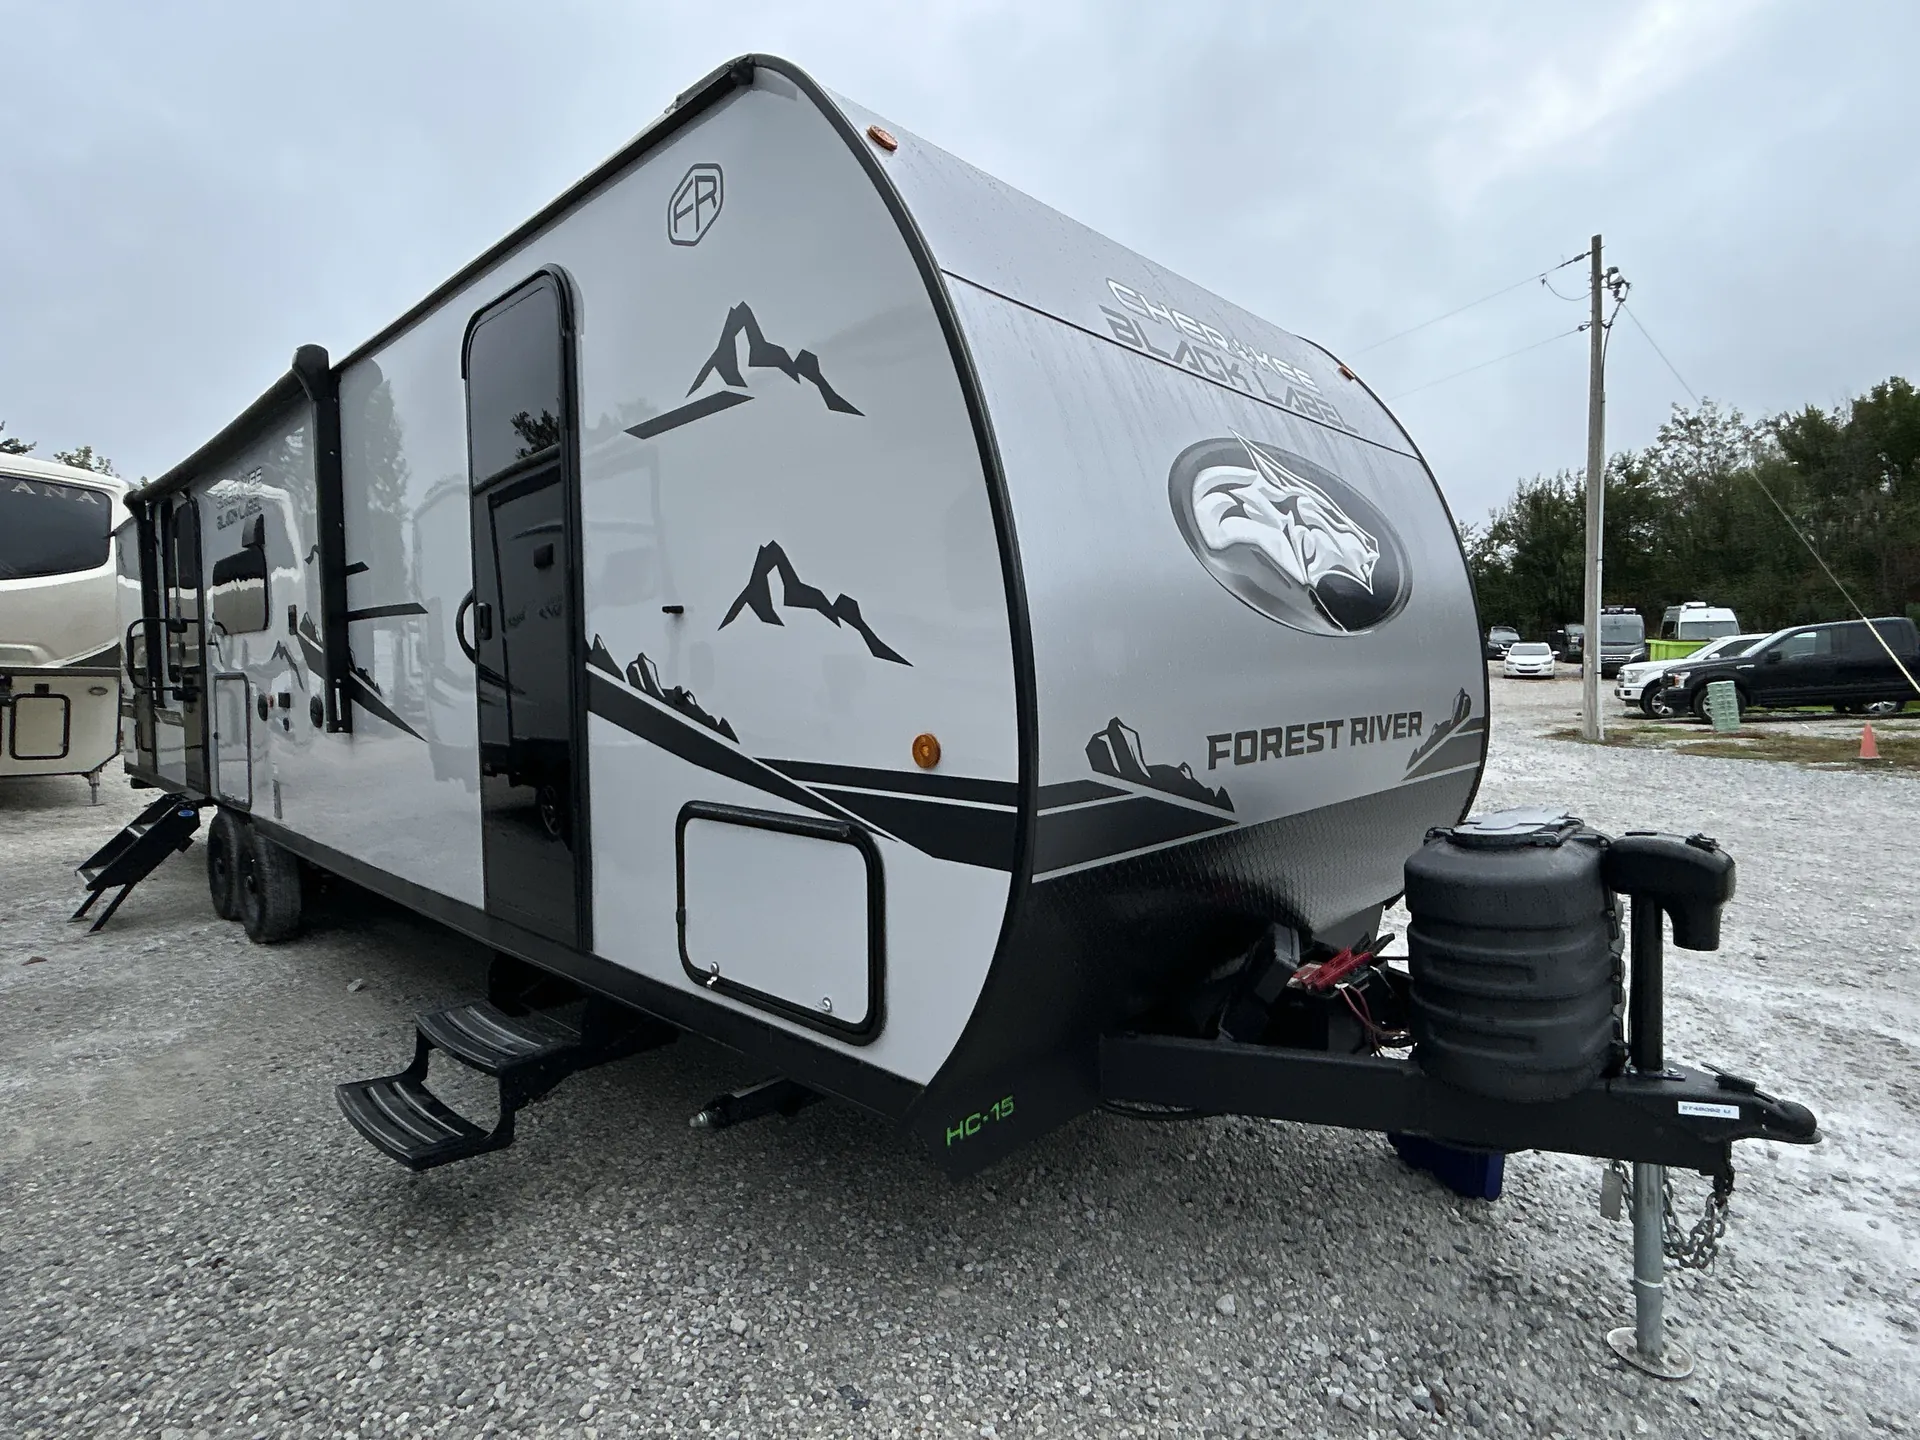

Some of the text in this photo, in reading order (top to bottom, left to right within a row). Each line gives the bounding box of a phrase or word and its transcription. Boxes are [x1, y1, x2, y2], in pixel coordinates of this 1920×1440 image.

[1098, 304, 1360, 434] BLACK LABEL
[0, 478, 100, 505] ANA
[1206, 711, 1423, 771] FOREST RIVER
[945, 1095, 1015, 1147] HC-15
